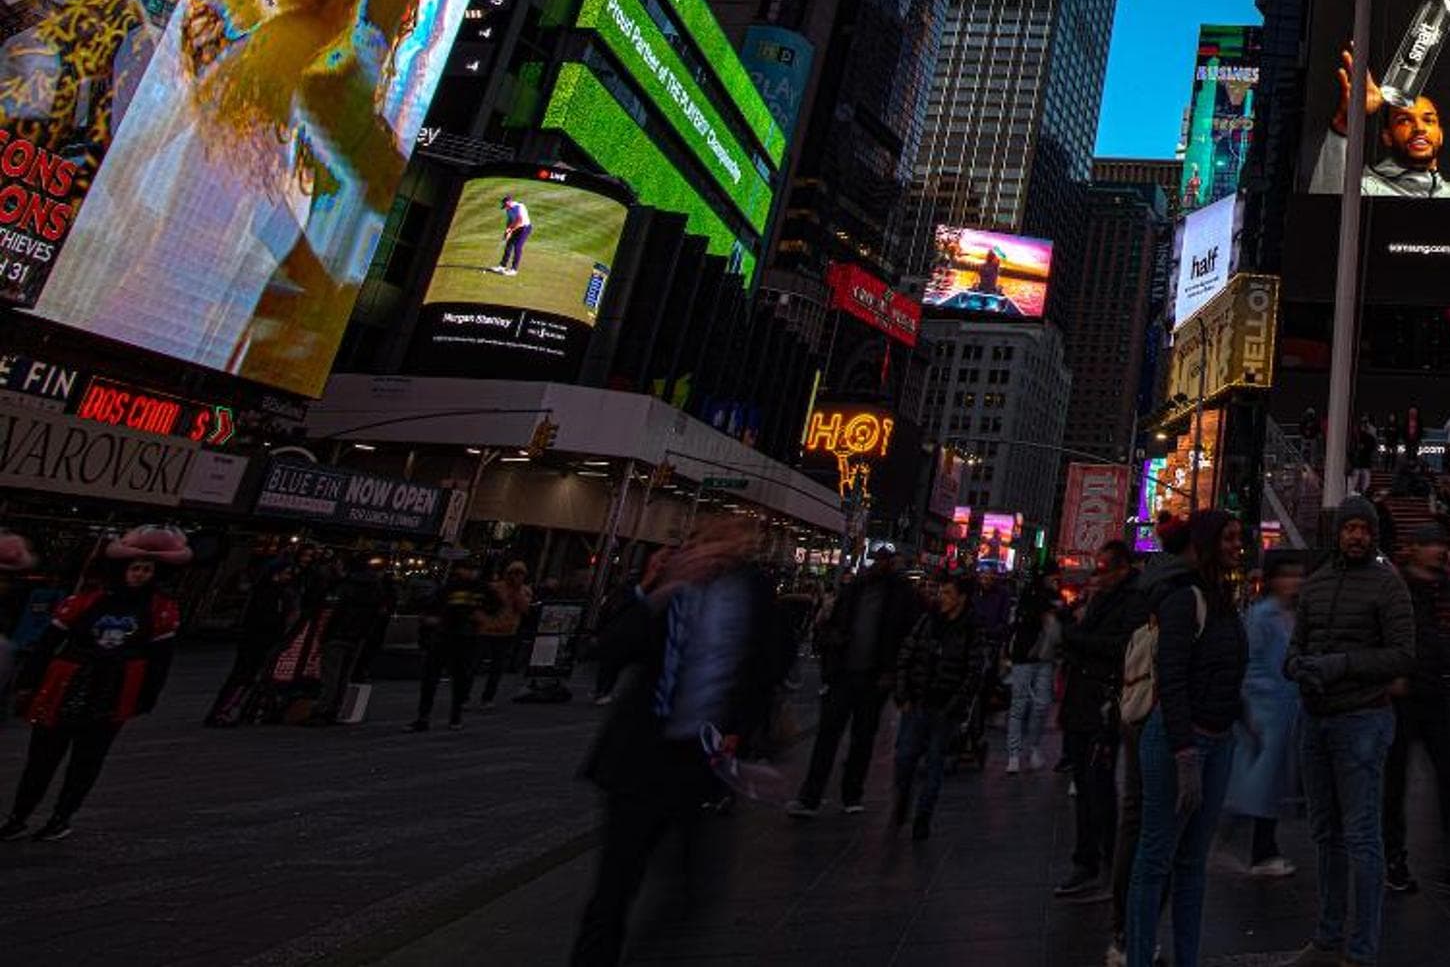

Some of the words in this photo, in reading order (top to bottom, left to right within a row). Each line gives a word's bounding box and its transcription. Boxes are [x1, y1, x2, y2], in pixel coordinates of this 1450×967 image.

[1408, 22, 1436, 62] smart
[1190, 245, 1219, 281] half
[22, 361, 78, 399] FIN
[79, 384, 129, 427] DOS
[267, 466, 313, 496] BLUE
[312, 474, 343, 499] FIN
[345, 474, 393, 508] NOW
[392, 481, 439, 516] OPEN
